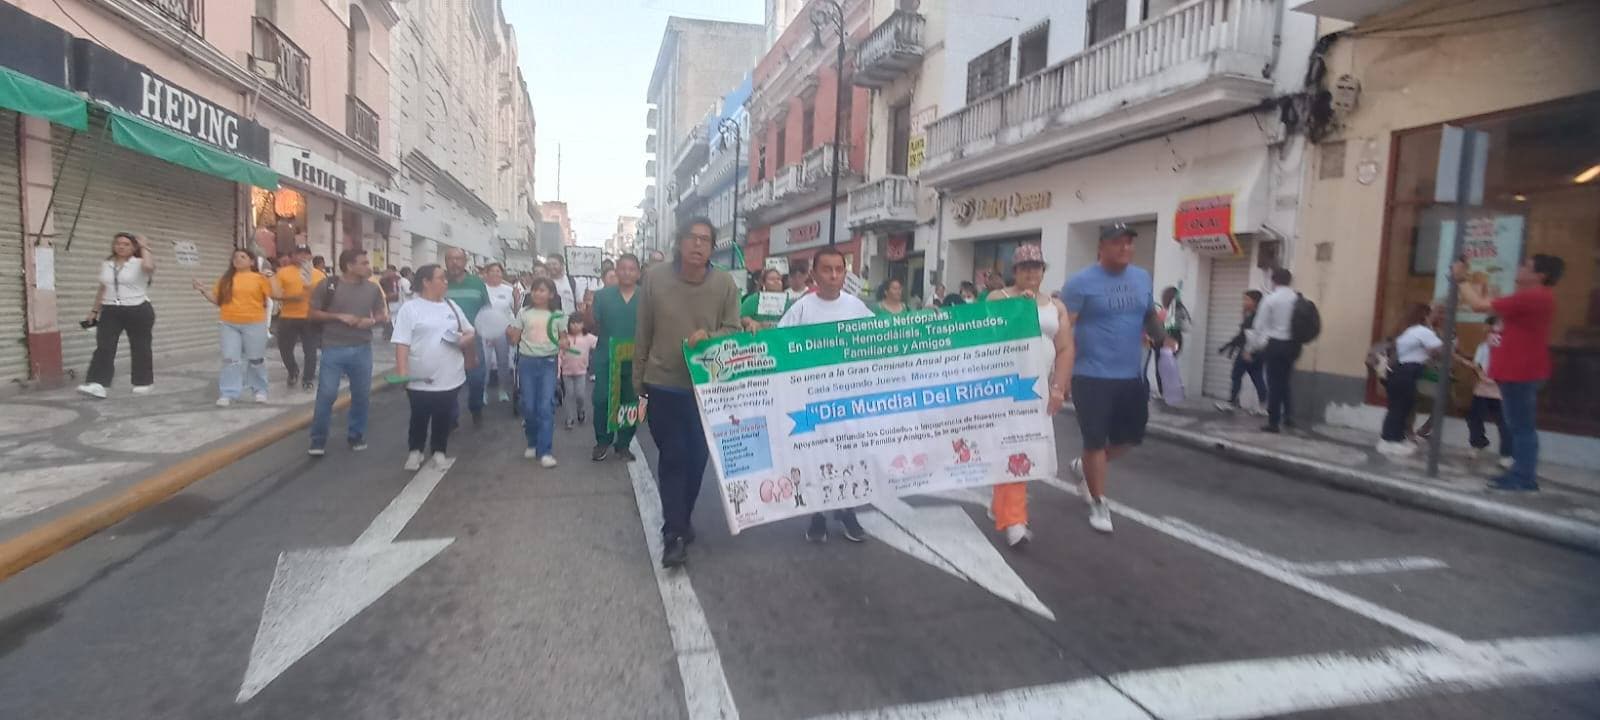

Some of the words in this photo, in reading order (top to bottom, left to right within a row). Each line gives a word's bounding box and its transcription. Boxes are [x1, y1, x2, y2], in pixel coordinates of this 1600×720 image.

[140, 71, 240, 150] HEPING
[788, 341, 802, 353] En
[926, 316, 1008, 336] Trasplantados,
[837, 319, 889, 333] Pacientes
[893, 311, 952, 327] Nefrópatas:
[732, 344, 766, 357] Mundial
[843, 343, 898, 359] Familiares
[902, 344, 908, 354] y
[910, 337, 952, 352] Amigos
[790, 375, 801, 384] Se
[804, 373, 825, 382] unen
[836, 368, 844, 377] la
[847, 366, 869, 376] Gran
[915, 355, 942, 366] Anual
[944, 353, 959, 365] por
[963, 351, 972, 361] la
[974, 346, 1001, 358] Salud
[1003, 343, 1029, 355] Renal
[850, 391, 917, 416] Mundial
[922, 388, 951, 405] Del
